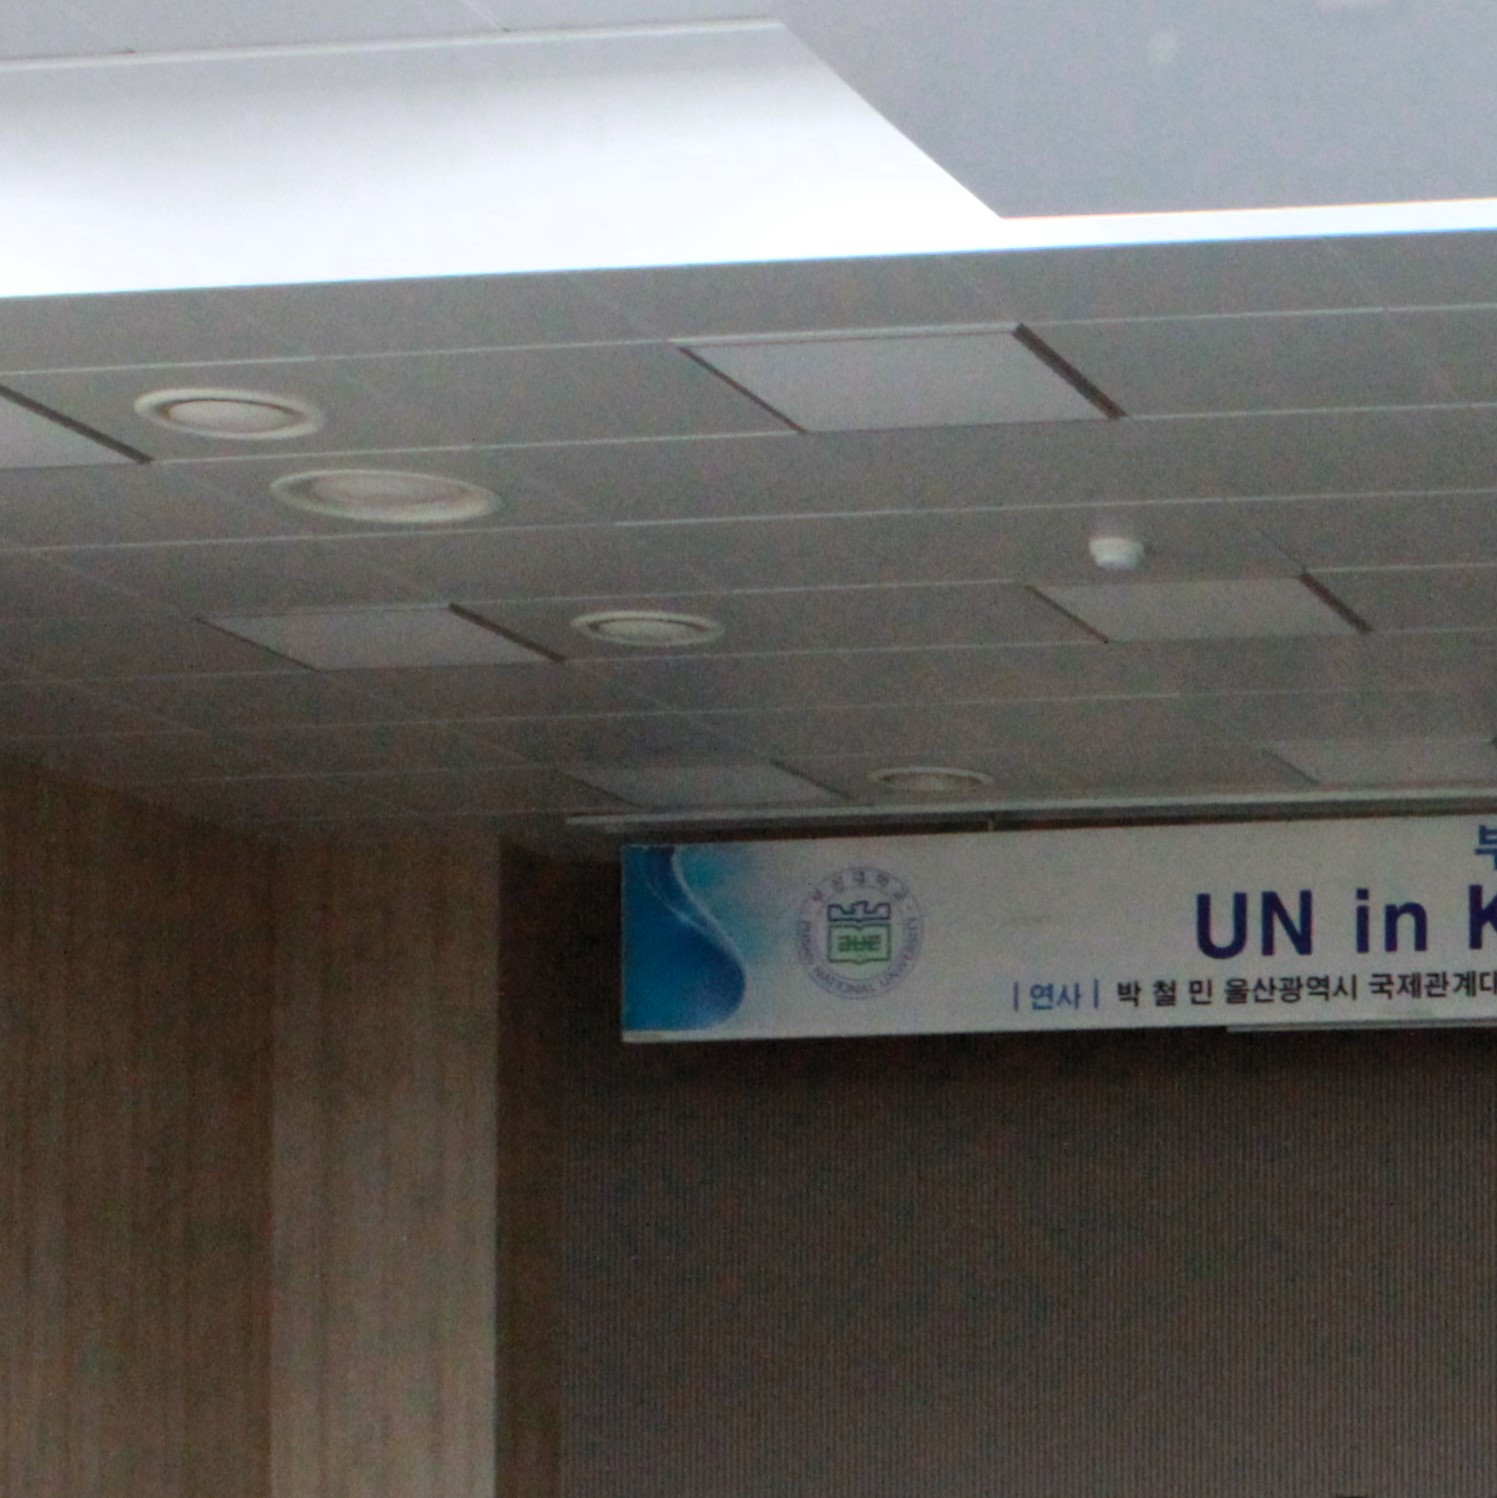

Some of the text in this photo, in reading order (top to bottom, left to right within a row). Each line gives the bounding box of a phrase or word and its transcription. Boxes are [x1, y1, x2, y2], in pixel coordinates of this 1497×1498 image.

[1196, 889, 1312, 960] UN
[1355, 887, 1428, 954] in
[1029, 982, 1082, 1011] 연사
[1117, 981, 1142, 1007] 박
[1153, 979, 1177, 1007] 철
[1188, 979, 1213, 1006] 민
[1224, 974, 1357, 1005] 울산광역시
